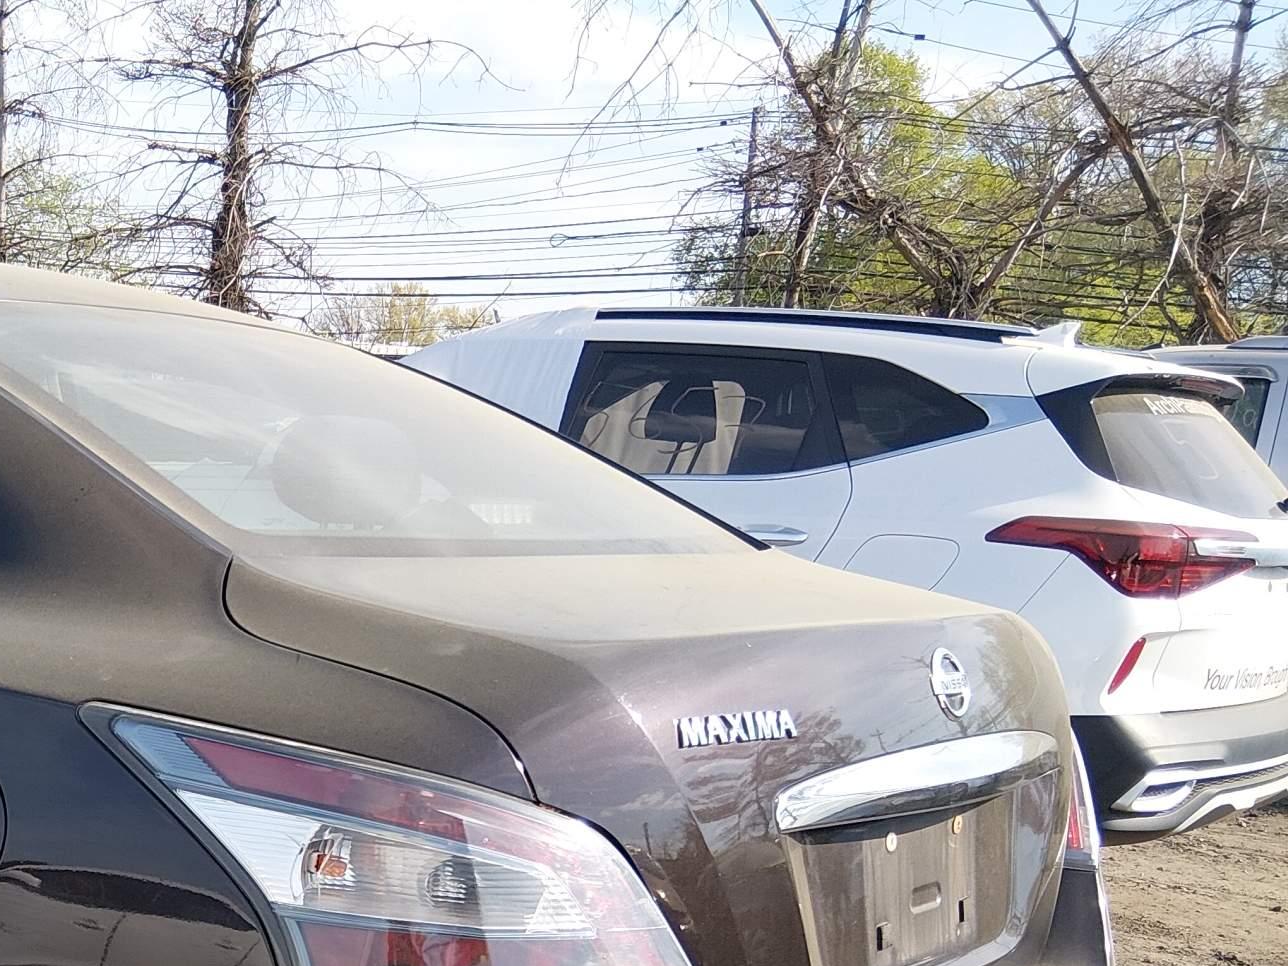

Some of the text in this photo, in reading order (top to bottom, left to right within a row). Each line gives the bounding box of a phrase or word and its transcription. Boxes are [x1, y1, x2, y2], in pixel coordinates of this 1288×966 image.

[1203, 667, 1234, 690] Your
[1234, 667, 1263, 689] Vision
[672, 709, 798, 749] MAXIMA
